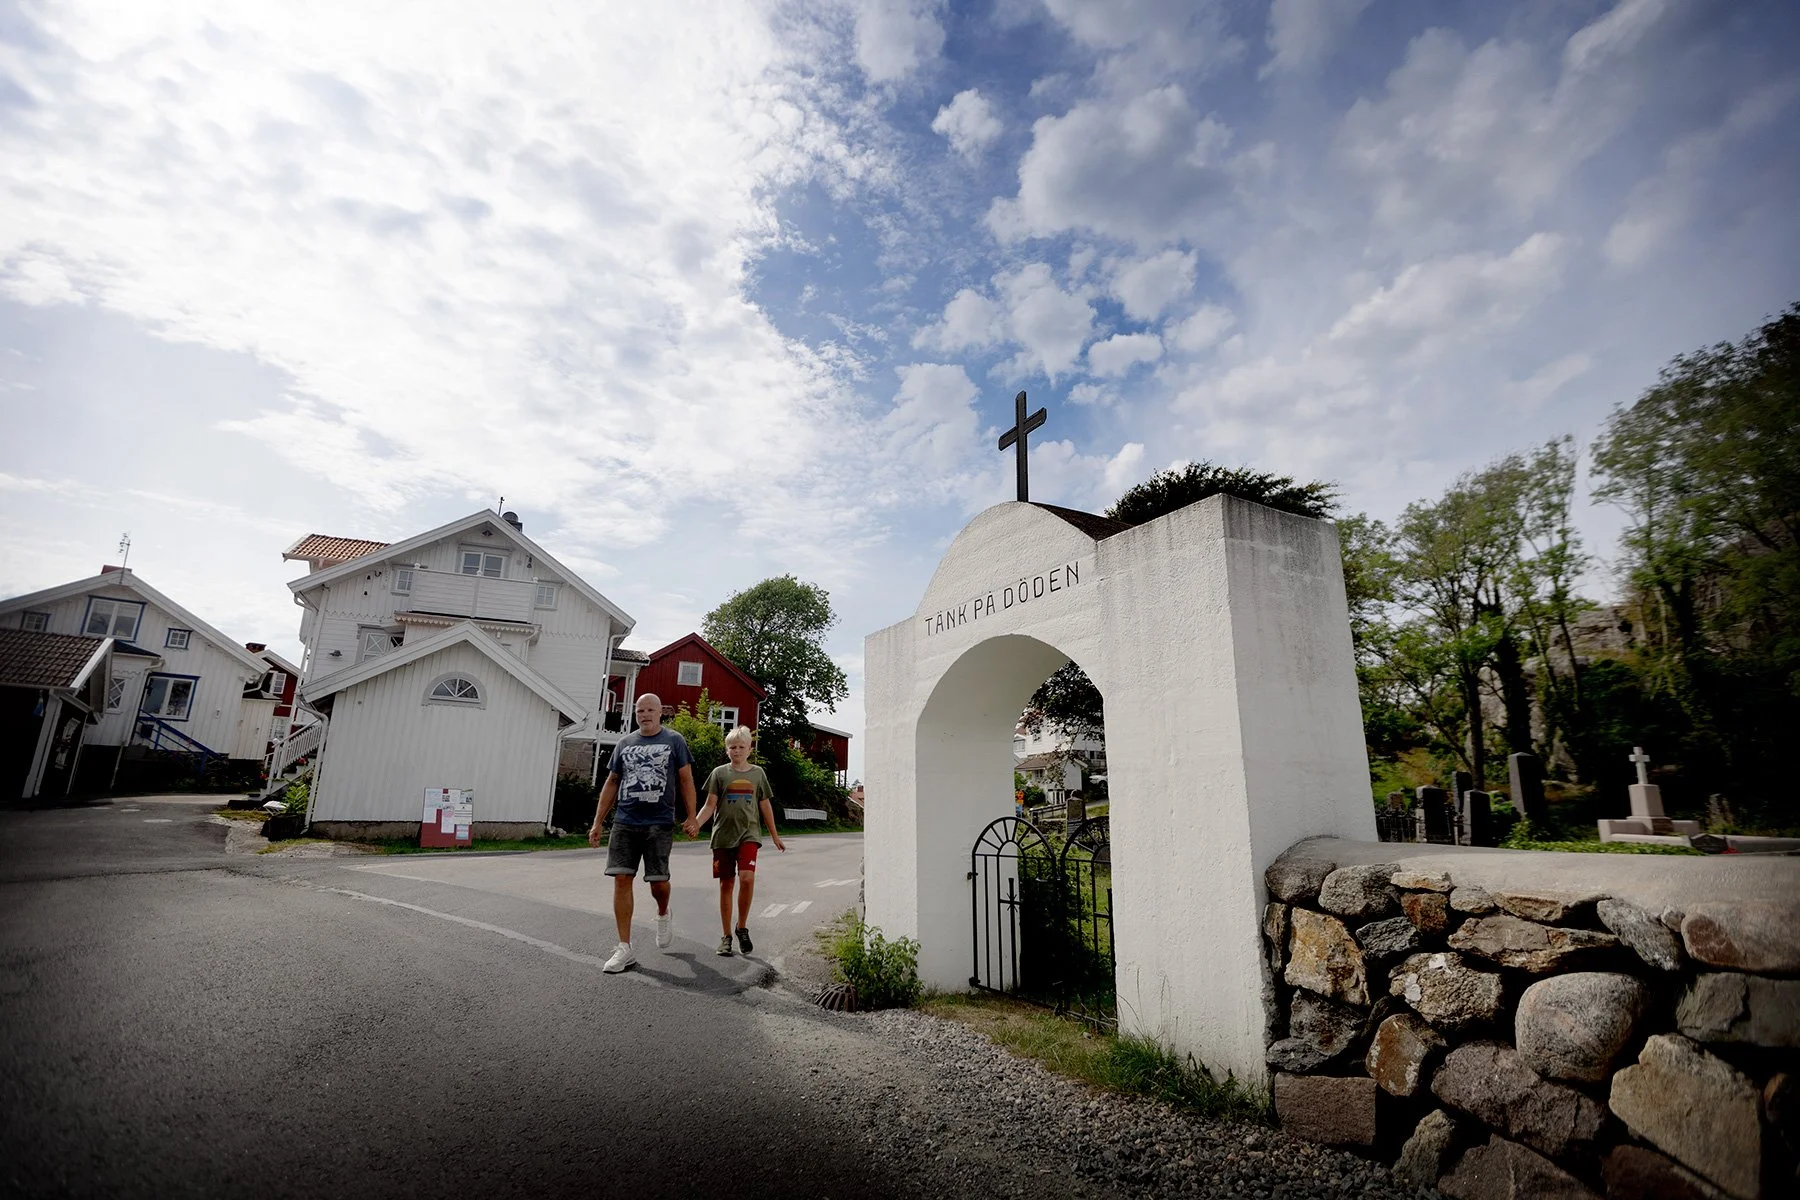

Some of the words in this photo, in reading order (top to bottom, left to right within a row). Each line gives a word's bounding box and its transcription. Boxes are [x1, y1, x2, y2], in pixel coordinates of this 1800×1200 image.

[925, 604, 967, 637] TÄNK
[973, 590, 996, 620] PÅ
[1003, 561, 1079, 609] DÖDEN
